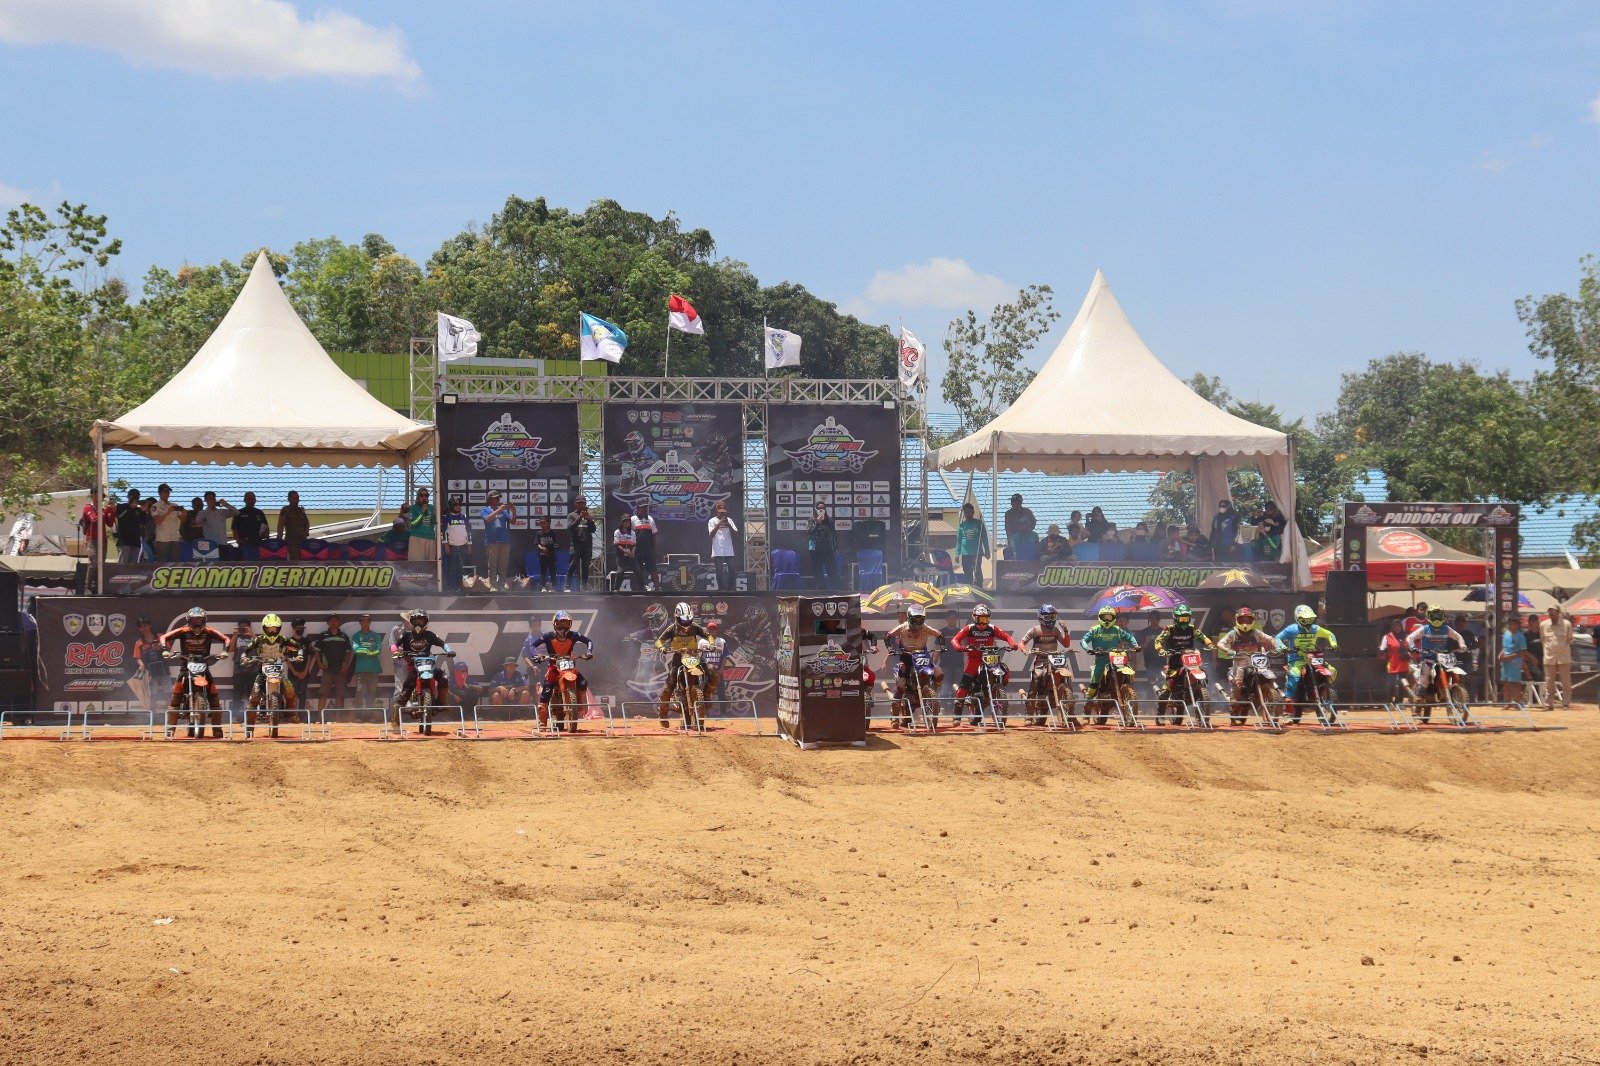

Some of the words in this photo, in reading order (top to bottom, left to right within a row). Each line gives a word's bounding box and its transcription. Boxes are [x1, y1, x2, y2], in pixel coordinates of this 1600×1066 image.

[449, 368, 472, 376] RUANG
[1383, 512, 1452, 525] PADDOCK
[1452, 512, 1483, 525] OUT
[152, 567, 257, 589] SELAMAT
[257, 566, 394, 589] BERTANDING
[706, 573, 719, 590] 3
[1039, 567, 1109, 587] JUNJUNG
[1109, 567, 1158, 587] TINGGI
[619, 579, 632, 592] 4
[736, 578, 748, 591] 5
[65, 641, 124, 668] RMC
[915, 656, 930, 666] 279
[264, 663, 282, 674] 122
[1255, 658, 1266, 666] 27
